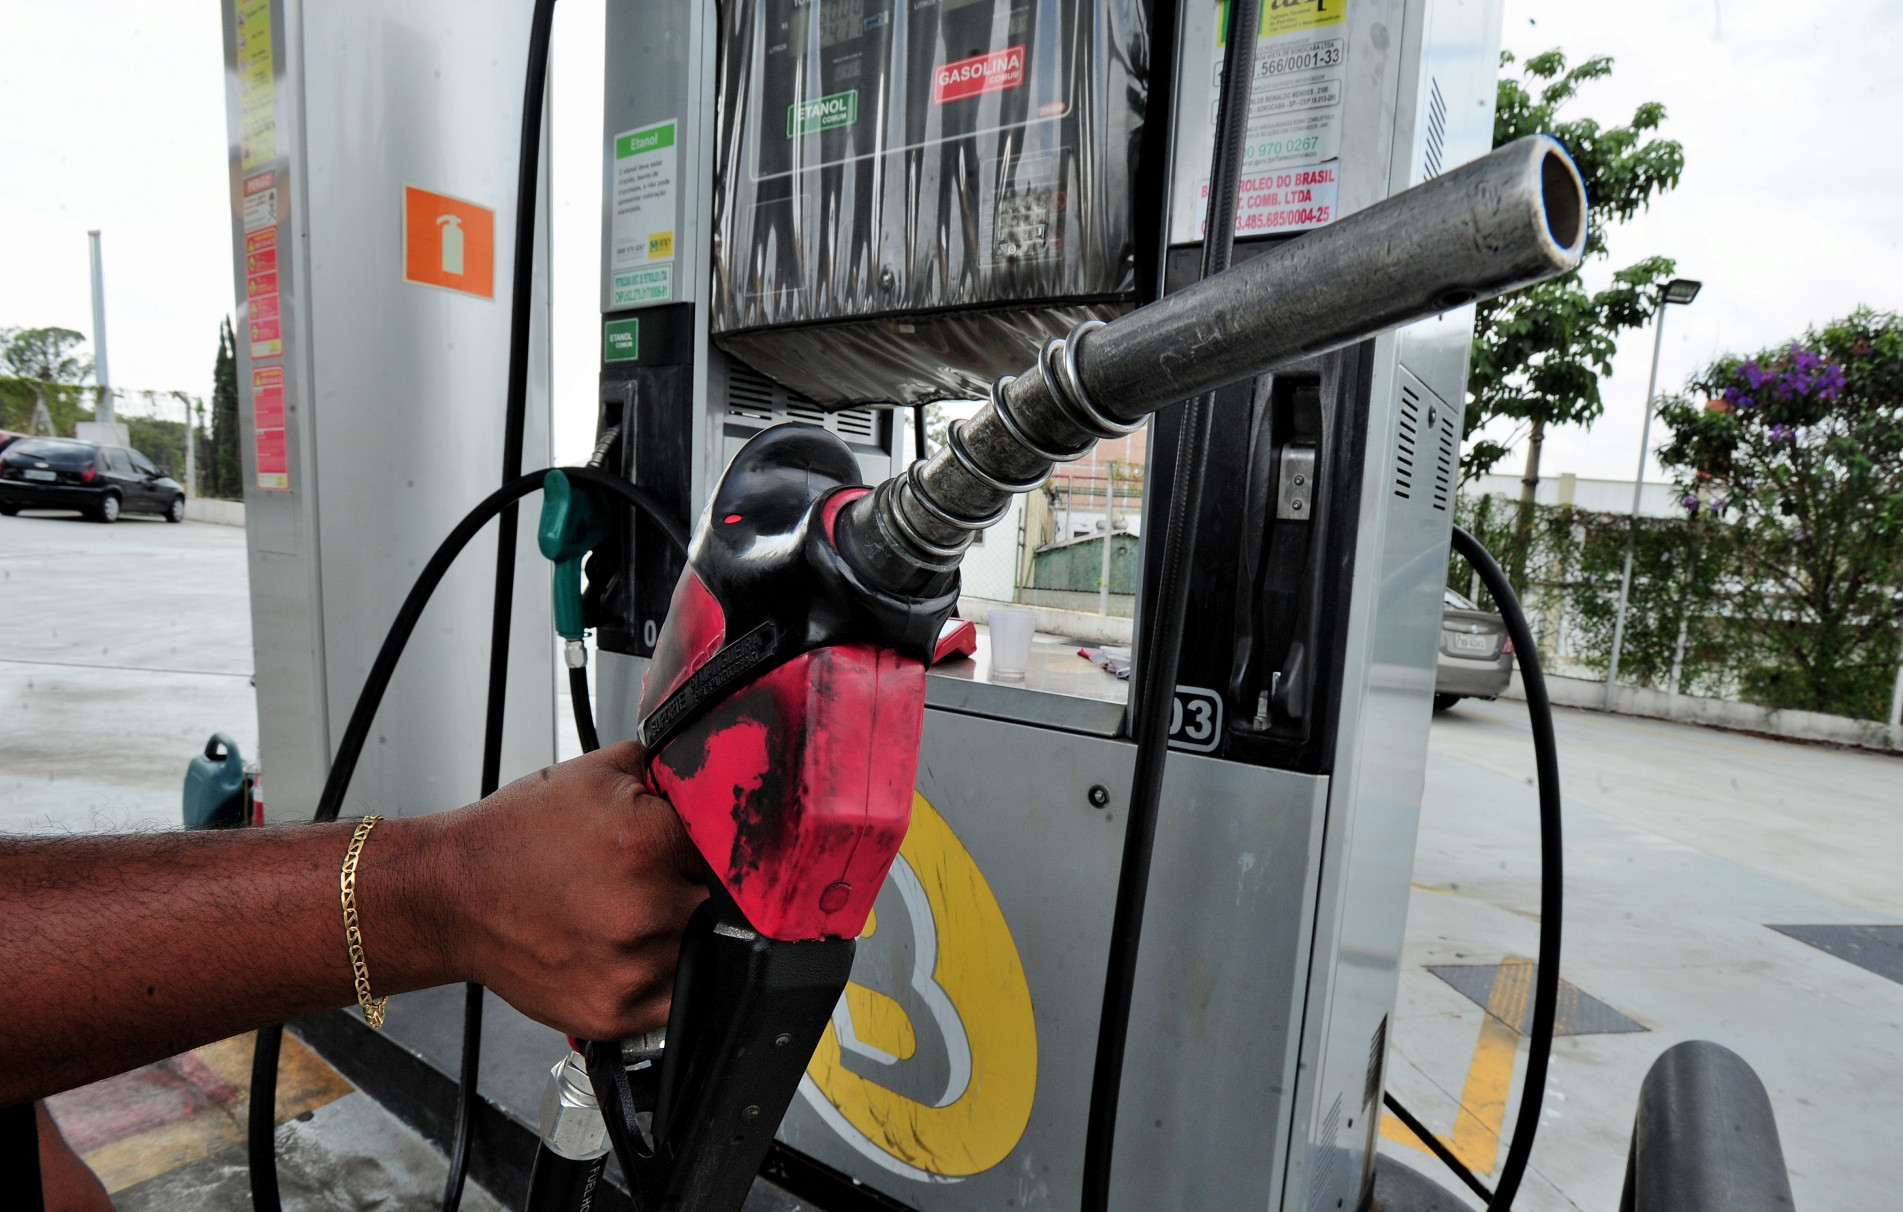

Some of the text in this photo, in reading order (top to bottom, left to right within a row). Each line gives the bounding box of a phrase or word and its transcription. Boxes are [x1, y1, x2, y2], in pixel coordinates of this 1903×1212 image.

[938, 54, 1020, 86] GASOLINA
[1257, 48, 1340, 77] .566/0001-33
[989, 71, 1020, 85] COMUM
[797, 98, 847, 121] ETANOL
[822, 112, 847, 124] COMUM
[630, 132, 658, 151] Etanol
[1259, 142, 1282, 157] 970
[1286, 136, 1319, 153] 0267
[1239, 177, 1273, 193] ROLEO
[1276, 174, 1291, 188] DO
[1295, 169, 1335, 186] BRASIL
[1247, 193, 1281, 209] COMB.
[1285, 189, 1312, 204] LTDA
[1236, 206, 1330, 231] 3.485.685/0004-25
[610, 332, 632, 343] ETANOL
